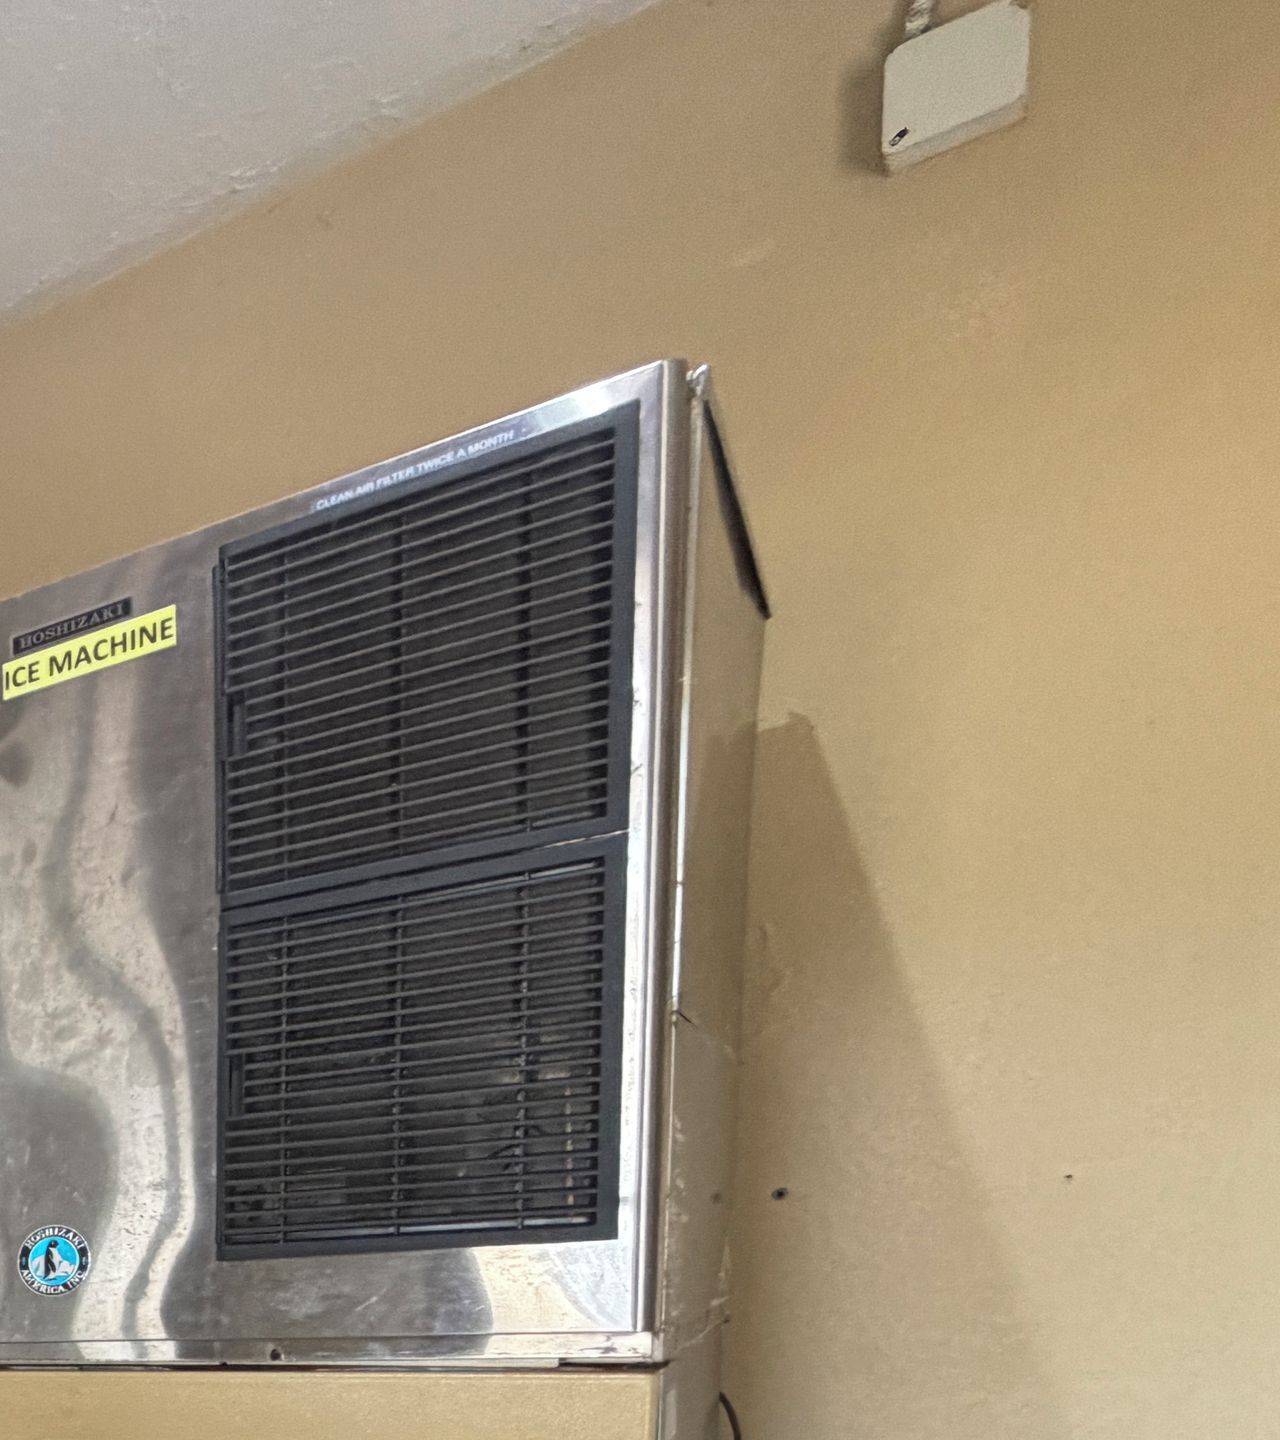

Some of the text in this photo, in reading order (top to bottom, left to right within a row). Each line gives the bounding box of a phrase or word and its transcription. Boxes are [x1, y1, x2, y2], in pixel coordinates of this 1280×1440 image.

[316, 430, 514, 511] CLEAN AIR FILTER TWICE A MONTH
[19, 602, 124, 650] HOSHIZAKI
[5, 617, 174, 691] ICE MACHINE
[24, 1227, 85, 1250] HOSHIZAKI
[21, 1269, 68, 1294] AMERICA
